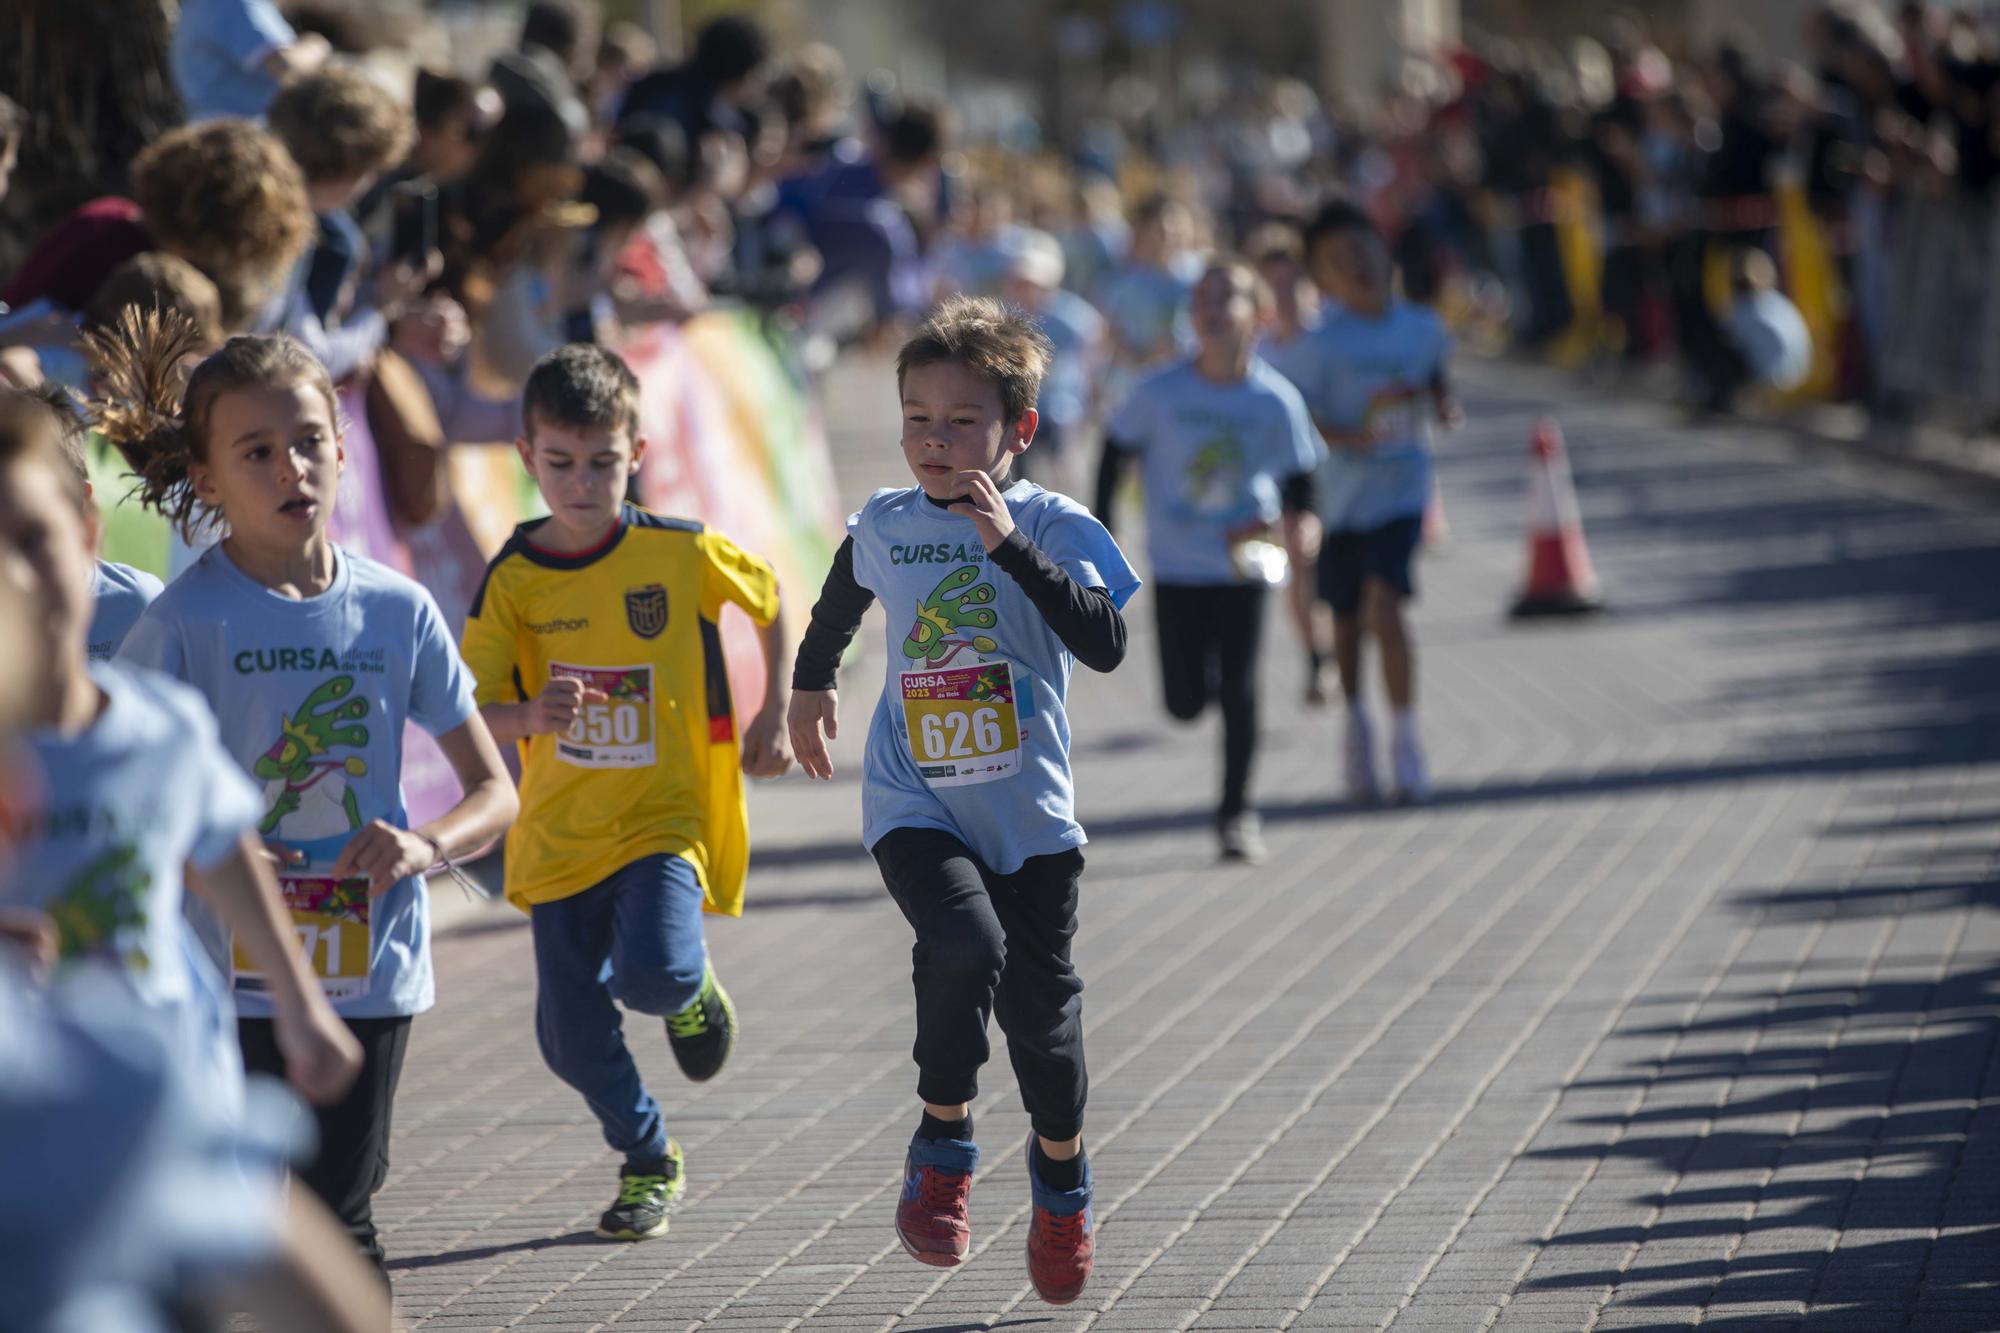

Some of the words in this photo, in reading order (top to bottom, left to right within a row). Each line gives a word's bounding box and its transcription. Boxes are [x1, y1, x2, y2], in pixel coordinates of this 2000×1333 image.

[889, 543, 968, 565] CURSA
[234, 648, 338, 675] CURSA
[904, 675, 947, 689] CURSA
[906, 688, 930, 698] 2023
[921, 707, 1002, 760] 626
[294, 924, 342, 976] 71
